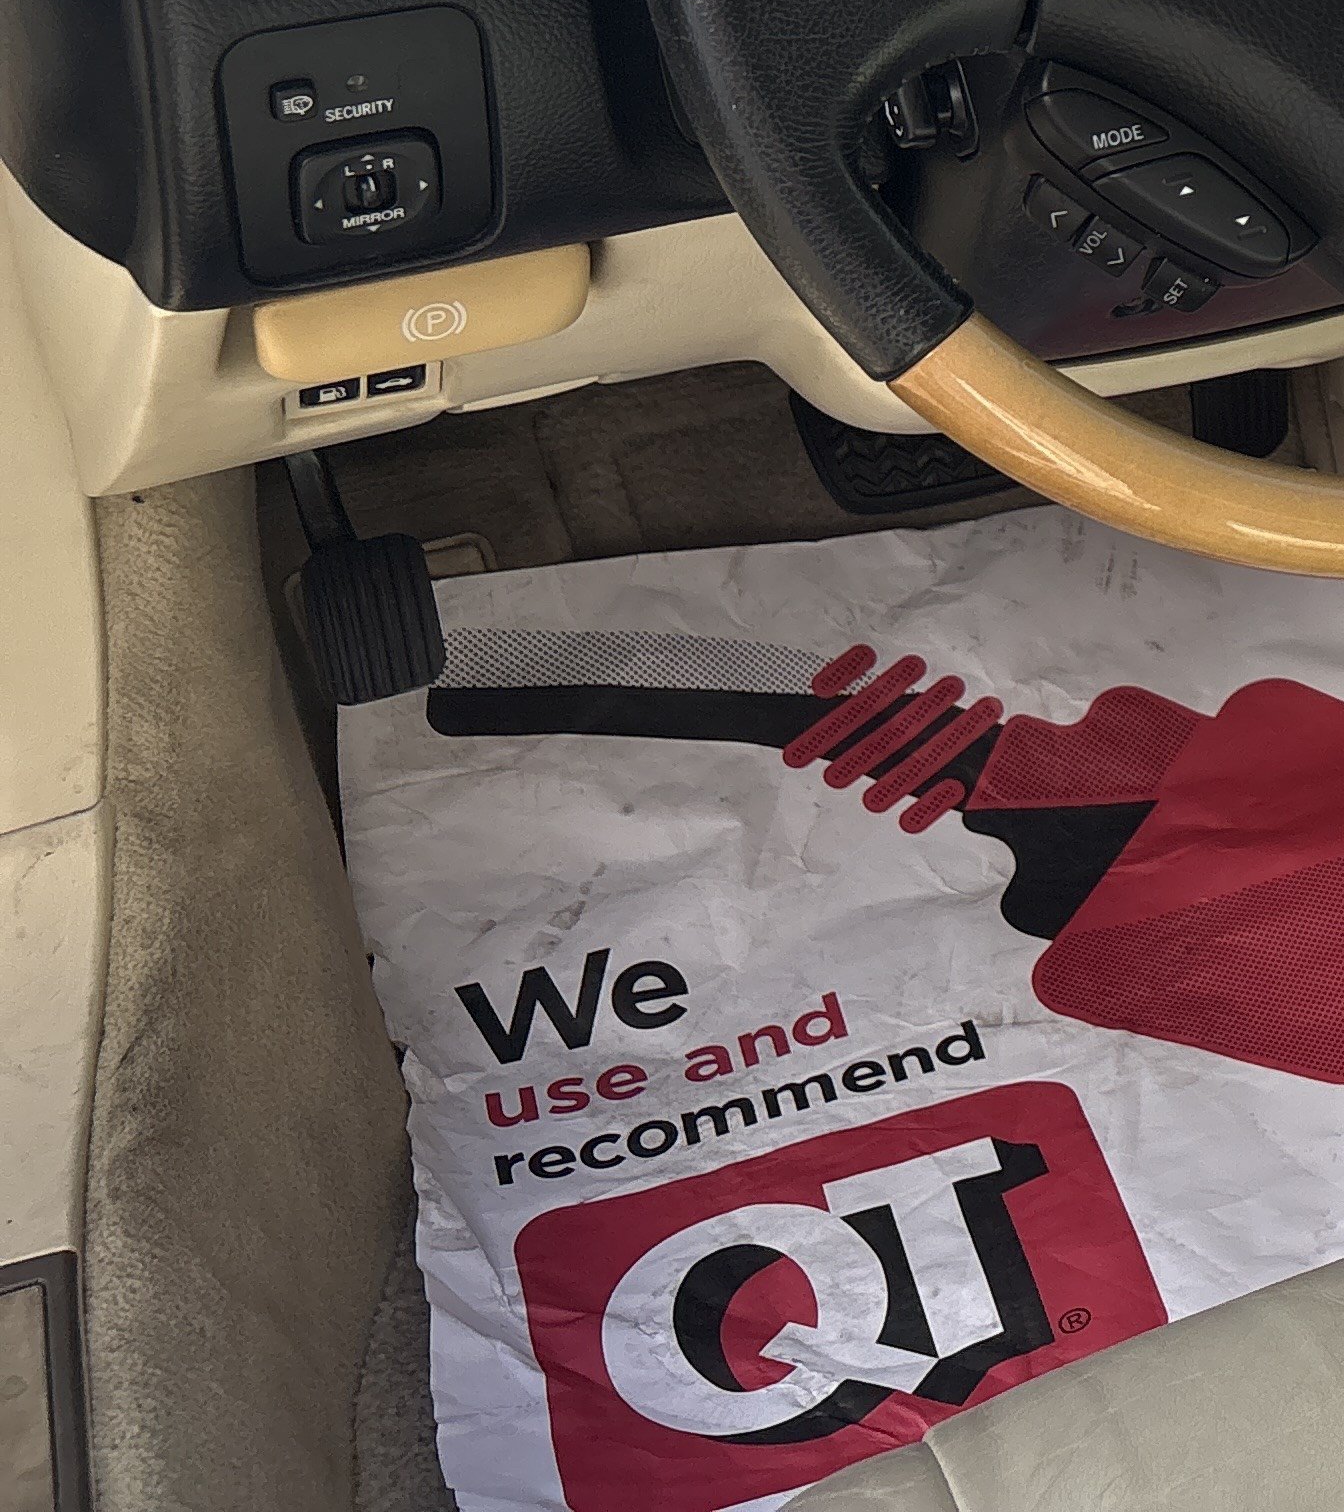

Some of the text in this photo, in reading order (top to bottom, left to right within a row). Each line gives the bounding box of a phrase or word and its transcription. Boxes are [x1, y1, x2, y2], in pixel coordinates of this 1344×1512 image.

[324, 98, 395, 124] SECURITY
[1092, 125, 1145, 150] MODE
[344, 158, 394, 176] L R
[342, 206, 406, 229] MIRROR
[1078, 228, 1108, 255] VOL
[1162, 277, 1189, 306] SET
[453, 947, 690, 1065] We
[483, 992, 849, 1129] use and
[492, 1020, 987, 1186] recommend
[601, 1136, 1030, 1442] QT
